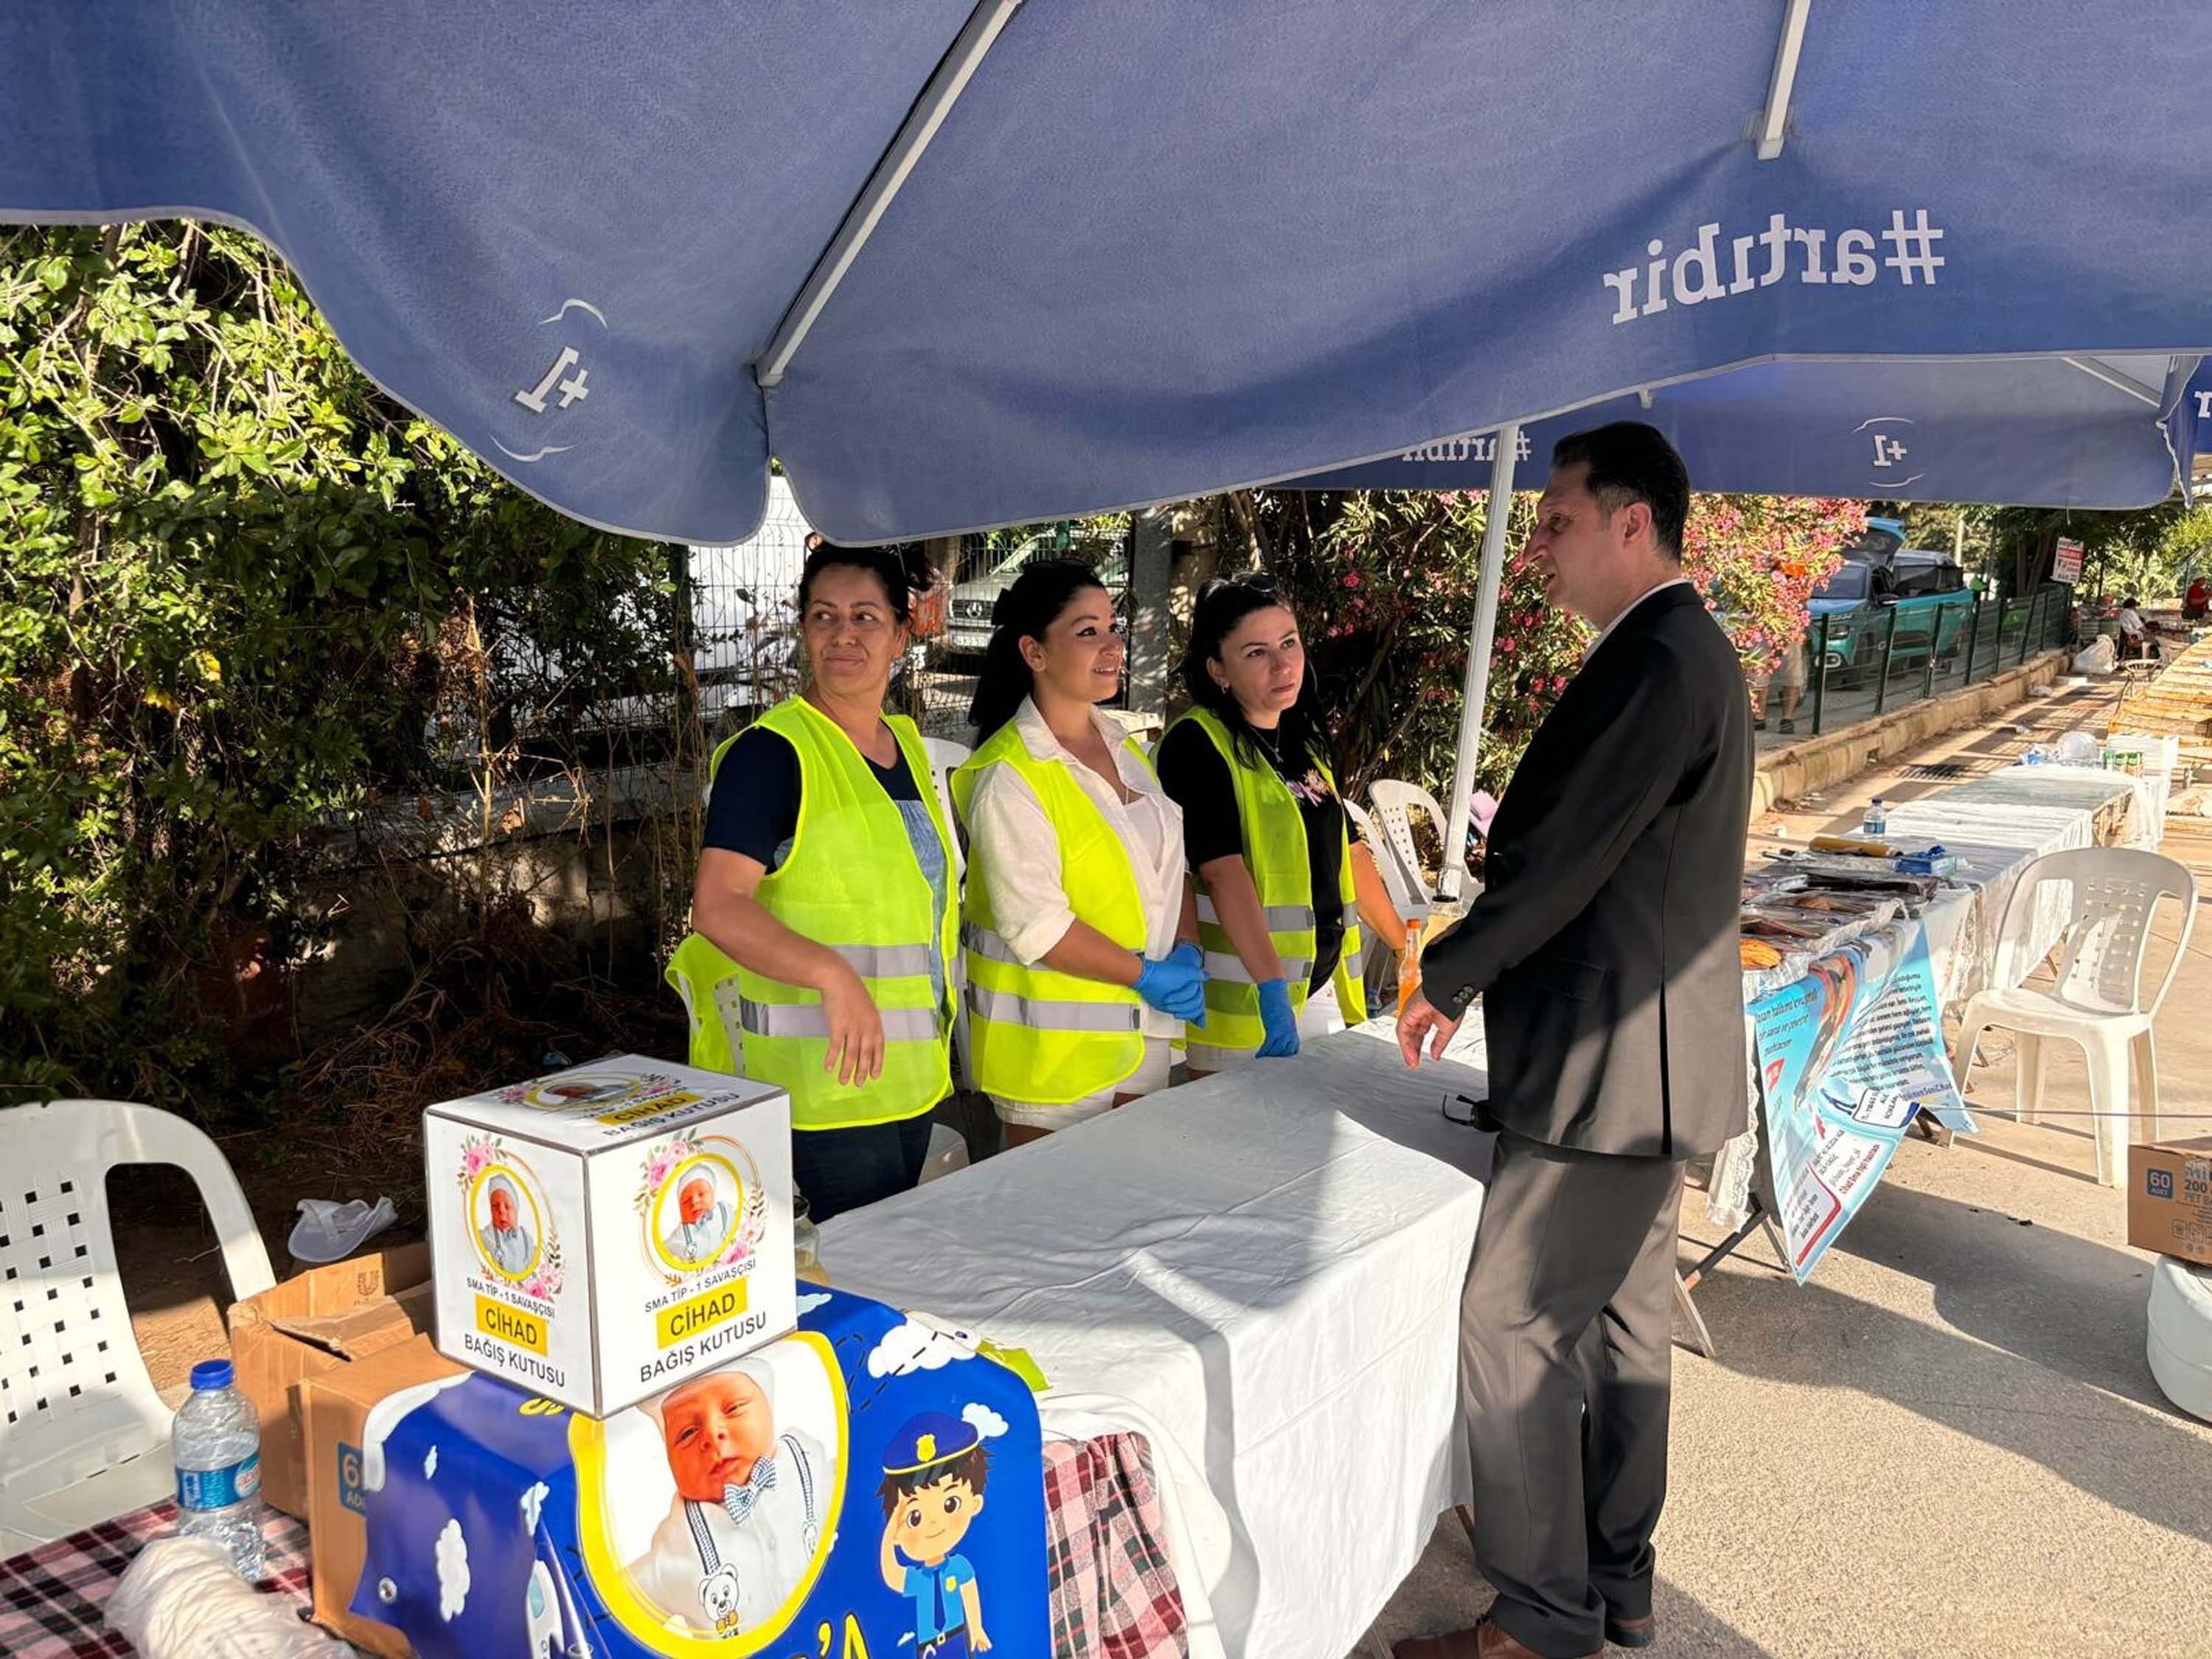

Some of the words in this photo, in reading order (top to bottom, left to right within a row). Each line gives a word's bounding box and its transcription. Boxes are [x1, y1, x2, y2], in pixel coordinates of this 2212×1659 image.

[2150, 1172, 2171, 1189] 60
[2184, 1179, 2208, 1193] 200
[467, 1277, 484, 1290] SMA
[486, 1283, 498, 1298] TİP
[505, 1292, 509, 1301] 1
[644, 1296, 669, 1312] SMA
[670, 1287, 687, 1301] TİP
[486, 1308, 537, 1344] CİHAD
[670, 1293, 735, 1337] CİHAD
[465, 1333, 505, 1367] BAĞIŞ
[509, 1351, 565, 1387] KUTUSU
[641, 1346, 695, 1382] BAĞIŞ
[700, 1311, 766, 1355] KUTUSU
